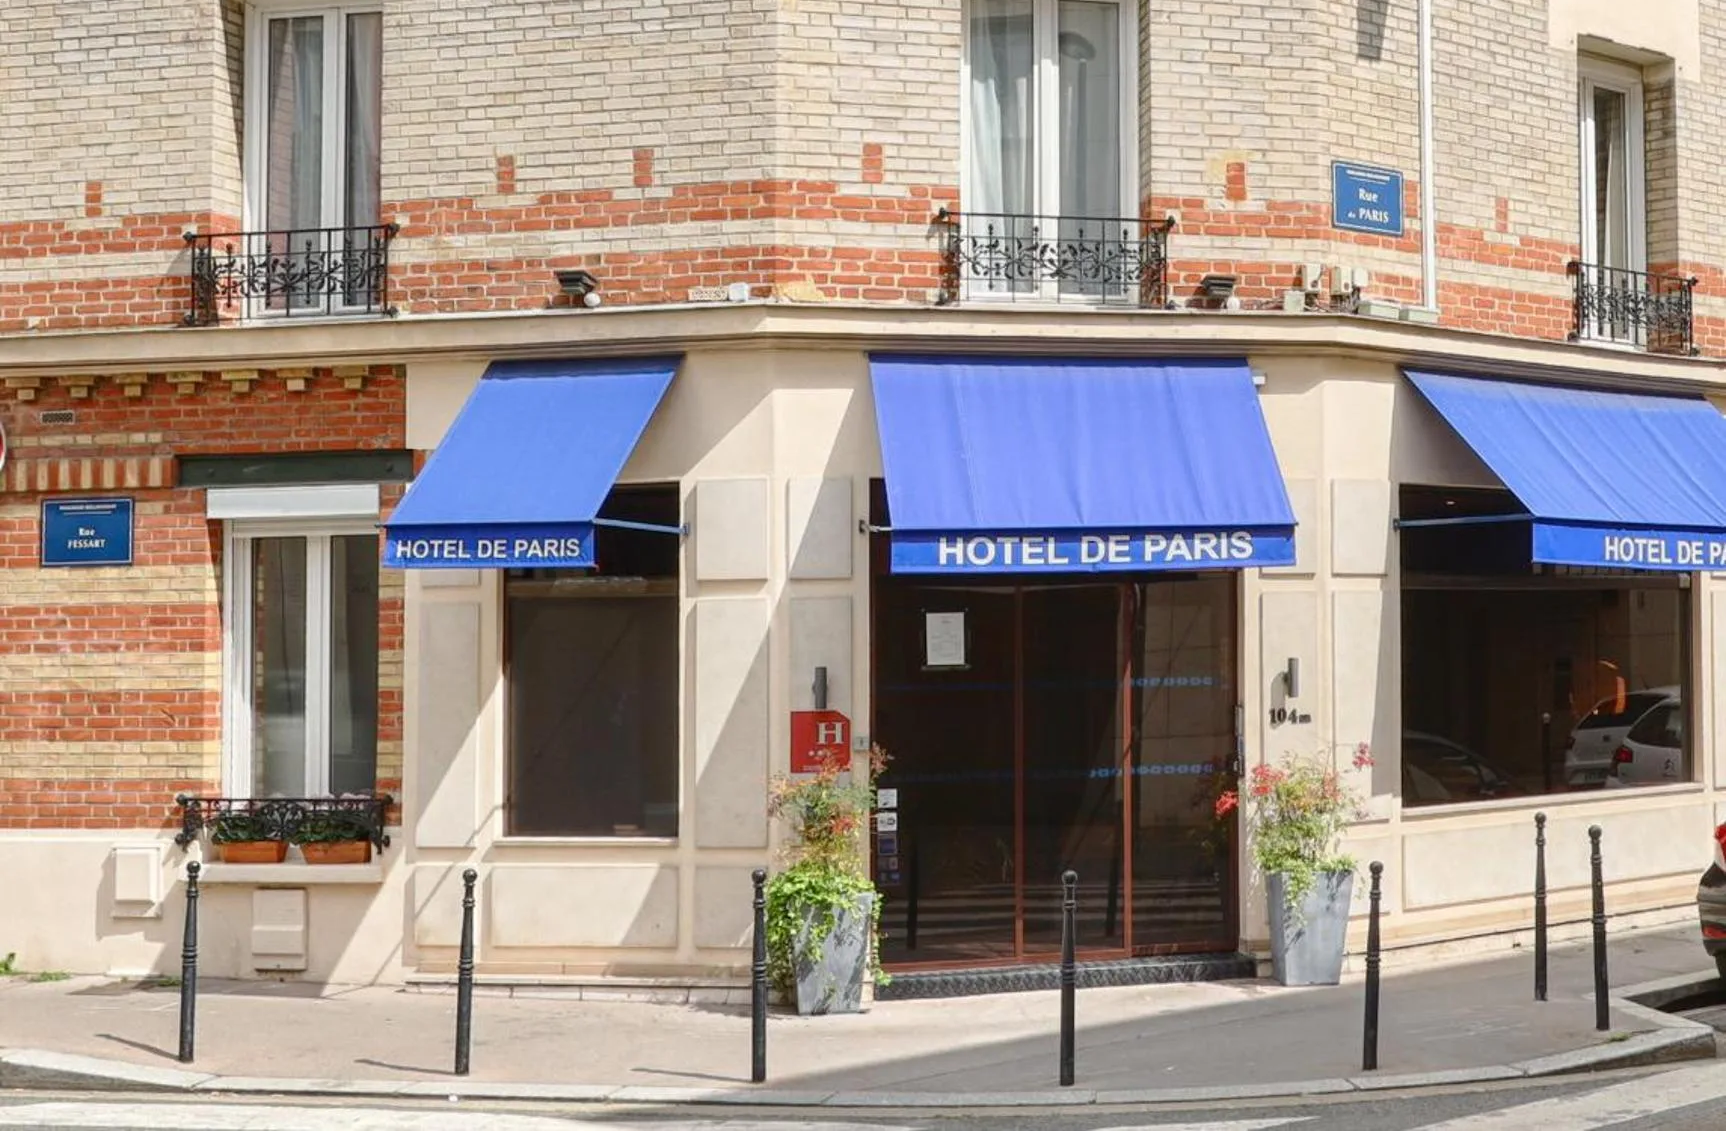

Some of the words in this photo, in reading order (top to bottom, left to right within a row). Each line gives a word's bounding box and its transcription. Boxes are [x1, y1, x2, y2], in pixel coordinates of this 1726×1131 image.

[1358, 187, 1379, 203] Rue
[1358, 207, 1389, 224] PARIS
[78, 527, 96, 536] Rue
[67, 538, 106, 549] FESSART
[396, 539, 471, 559] HOTEL
[477, 539, 509, 559] DE
[513, 538, 581, 559] PARIS
[938, 536, 1069, 566] HOTEL
[1080, 534, 1132, 564] DE
[1144, 531, 1254, 563] PARIS
[1604, 535, 1673, 564] HOTEL
[1677, 539, 1704, 565] DE
[816, 721, 845, 744] H
